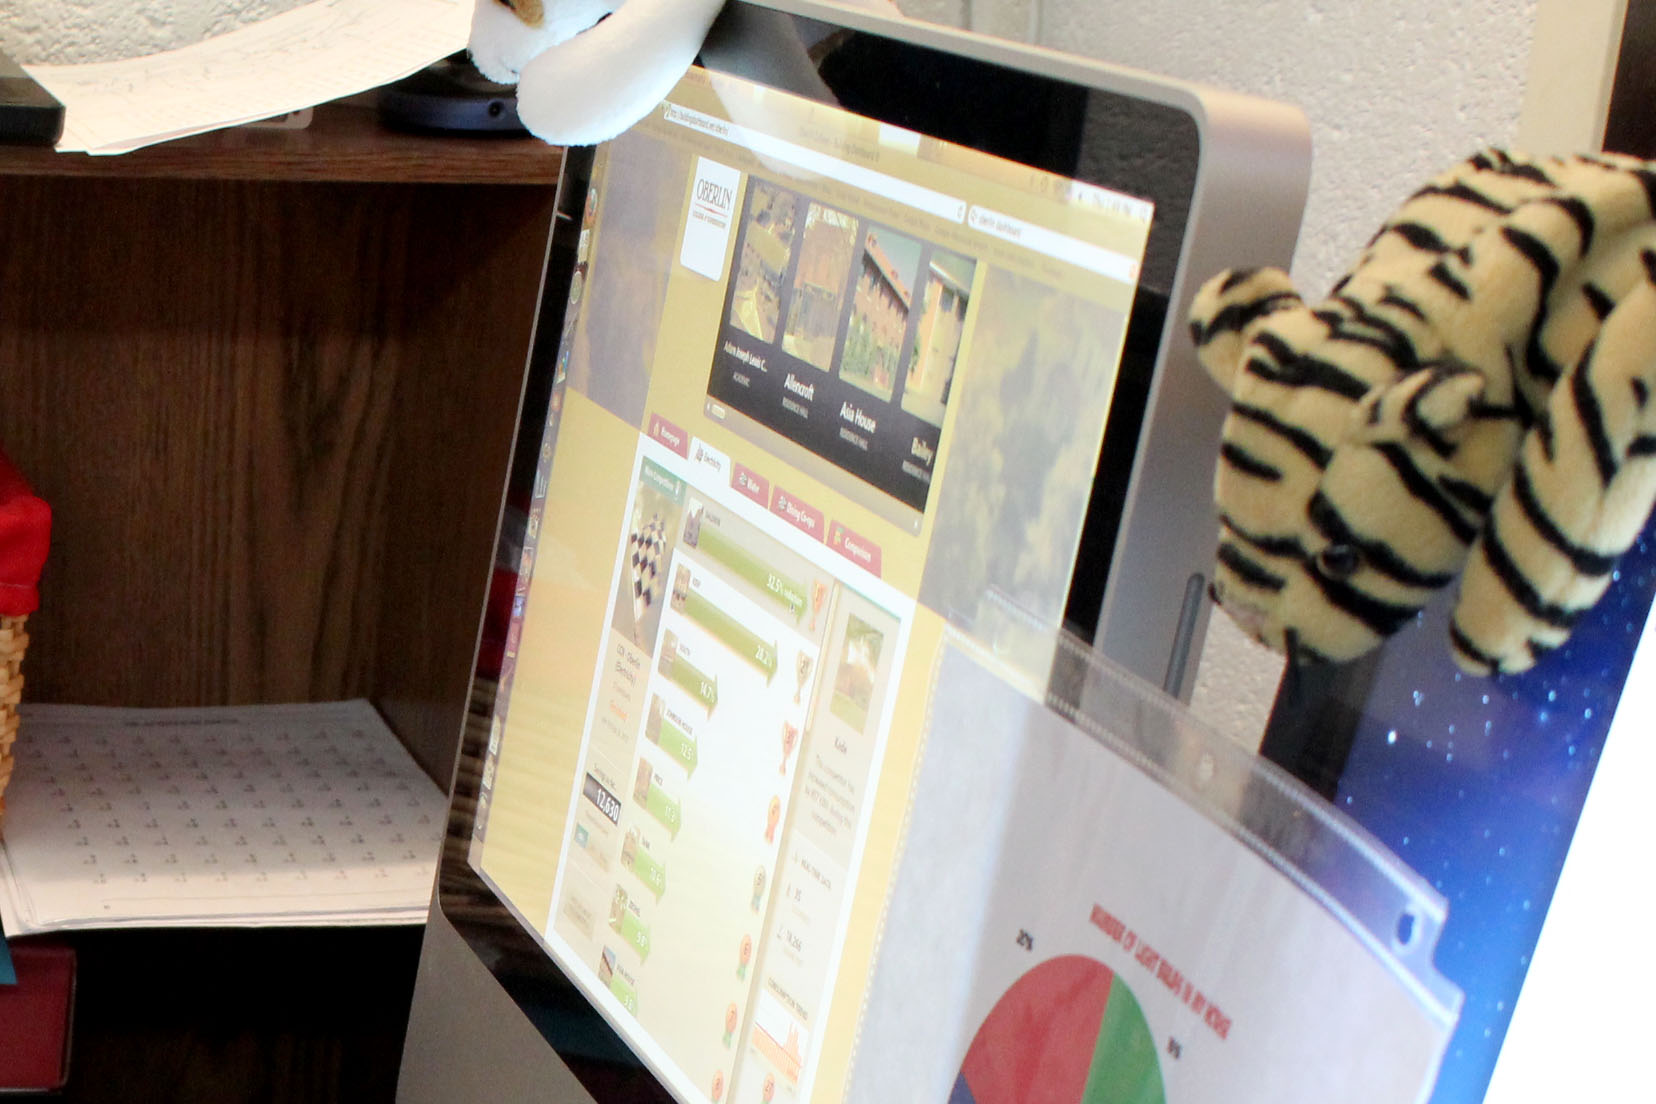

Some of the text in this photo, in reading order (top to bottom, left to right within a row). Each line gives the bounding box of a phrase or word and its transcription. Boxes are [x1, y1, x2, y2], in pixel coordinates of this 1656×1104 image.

[697, 178, 732, 210] OBERLIN
[785, 373, 813, 401] Allencroft
[840, 401, 876, 432] Asia House
[596, 789, 619, 821] 12,630
